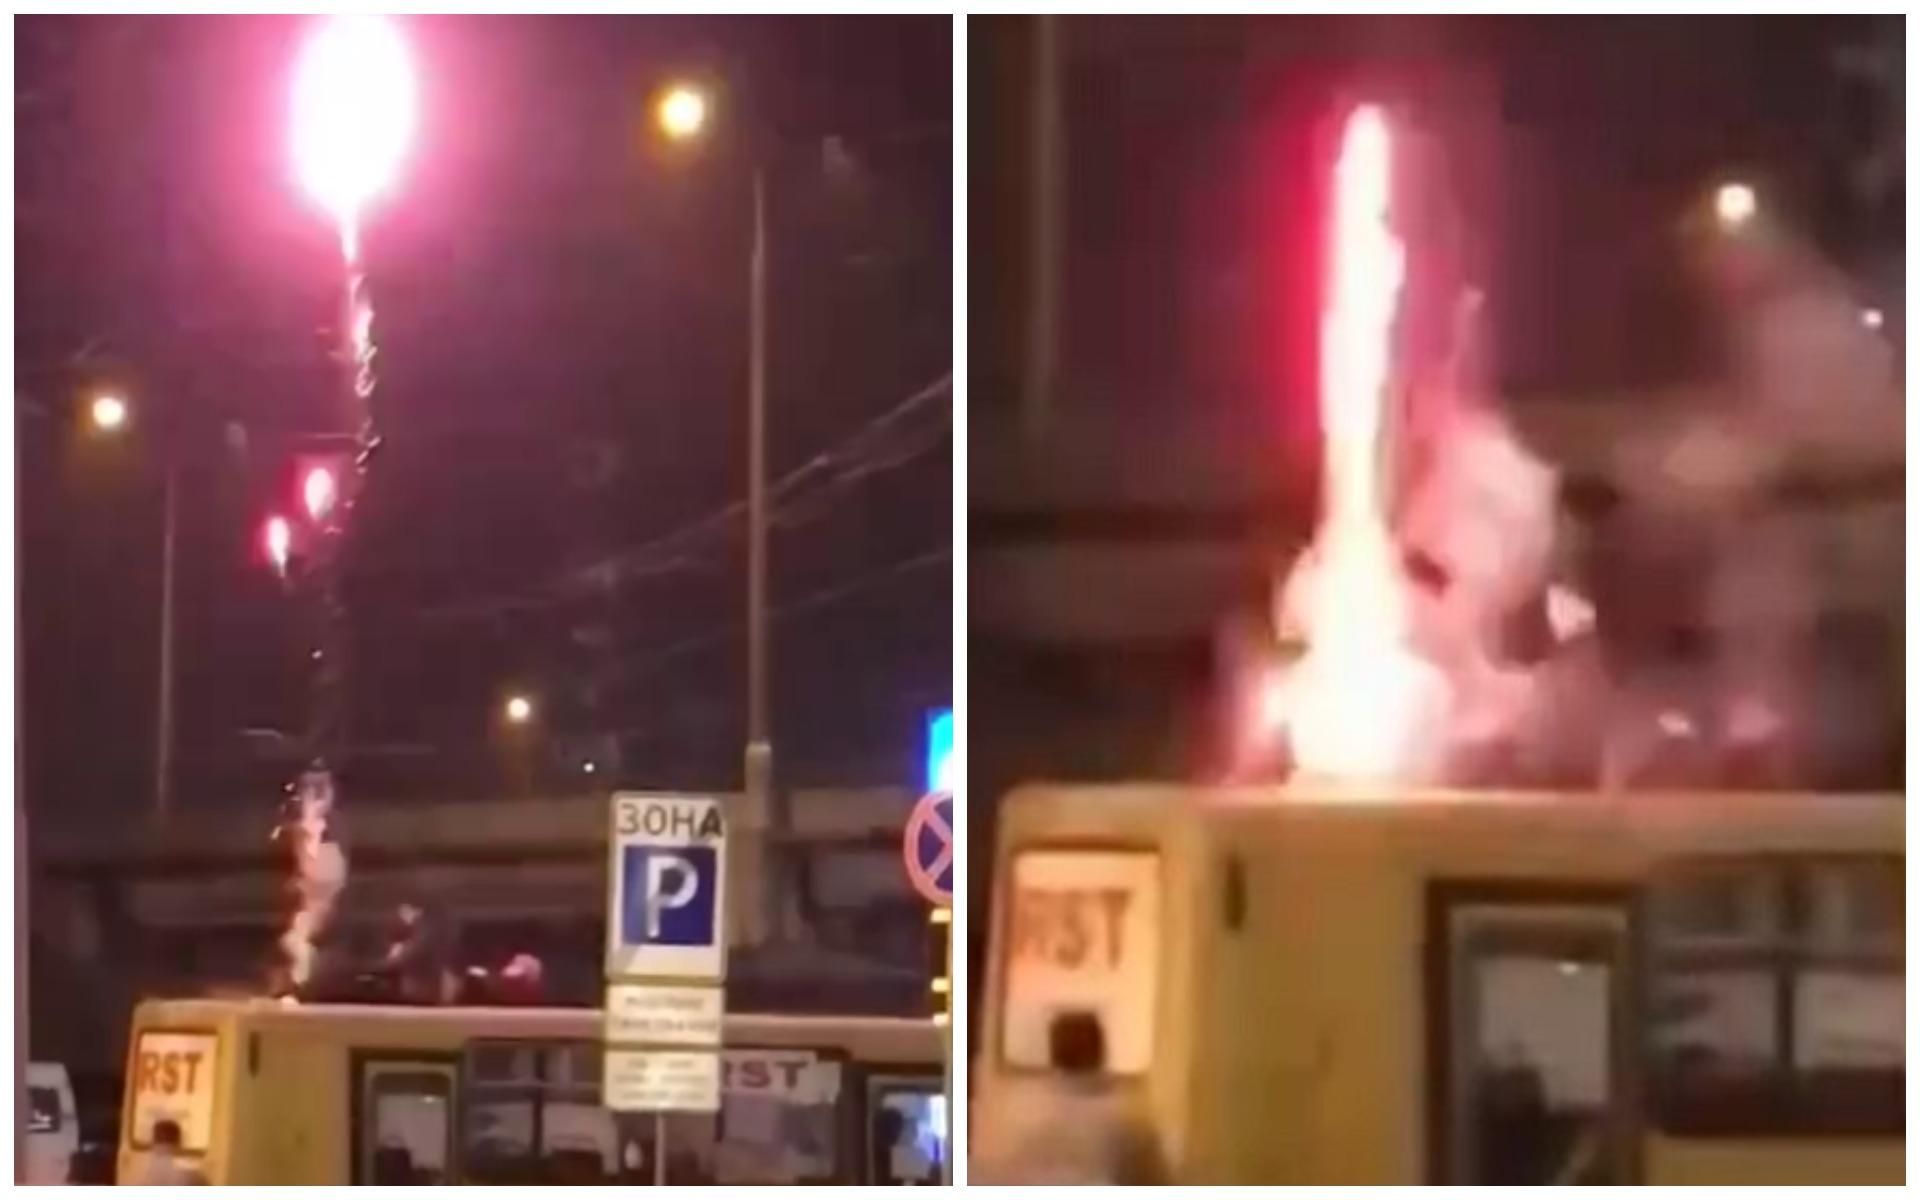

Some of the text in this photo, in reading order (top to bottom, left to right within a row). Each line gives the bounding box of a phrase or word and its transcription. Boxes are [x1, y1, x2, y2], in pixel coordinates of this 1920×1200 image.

[619, 802, 724, 838] ЗОНА
[647, 856, 699, 938] P
[138, 1051, 204, 1095] RST
